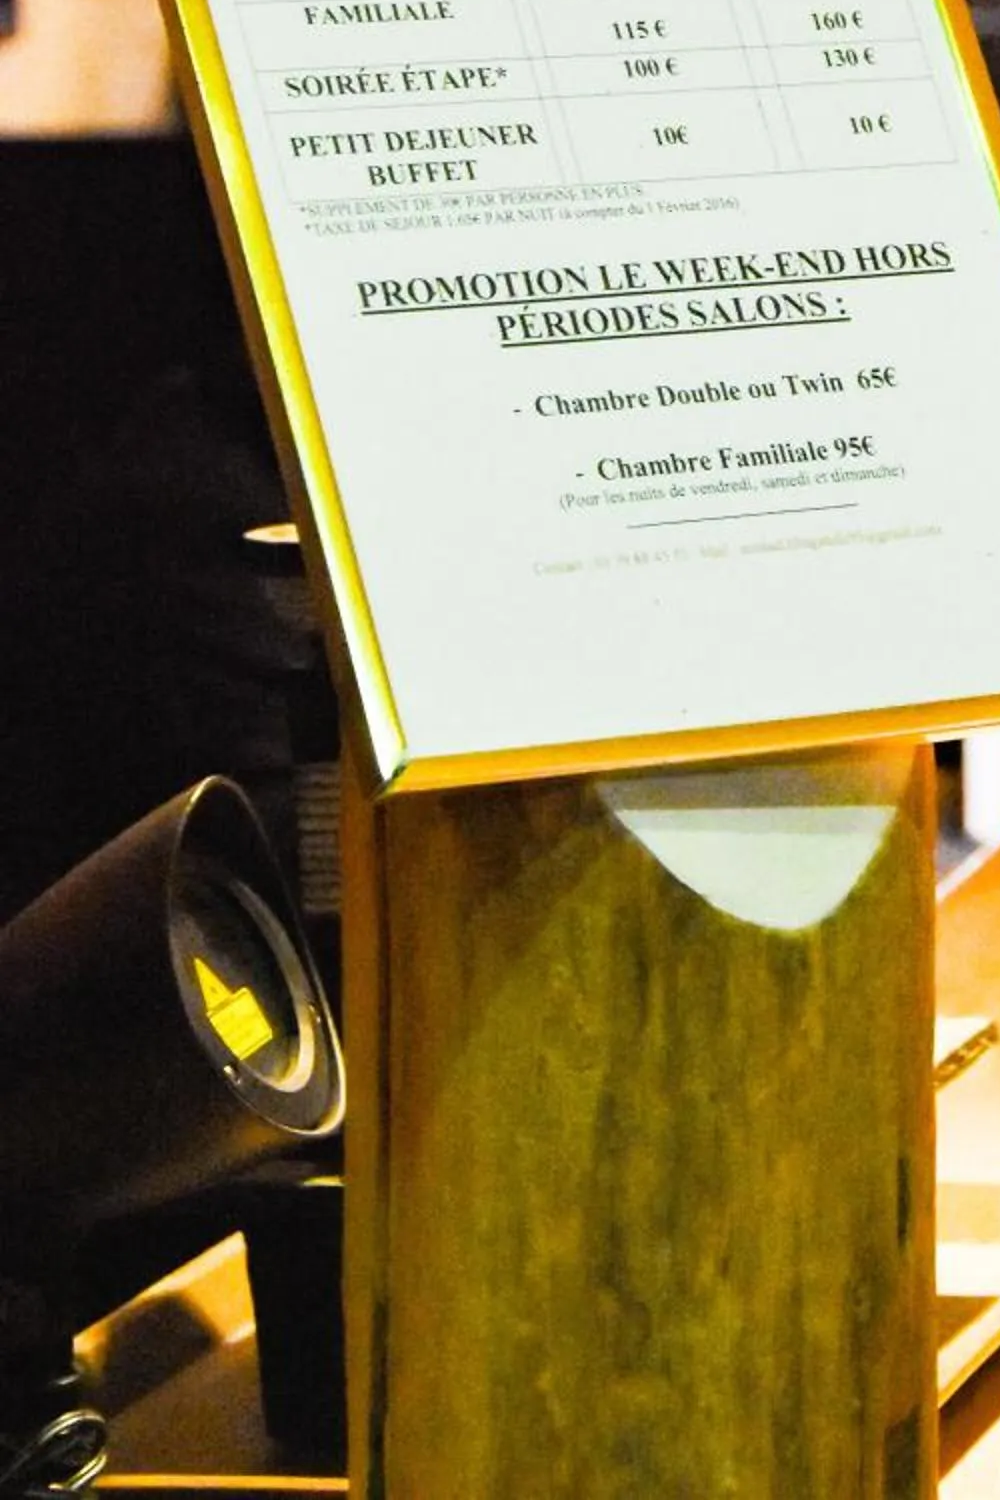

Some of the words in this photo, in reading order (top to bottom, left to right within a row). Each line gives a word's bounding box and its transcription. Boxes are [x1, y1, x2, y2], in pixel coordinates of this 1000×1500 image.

[304, 2, 454, 25] FAMILIALE
[812, 12, 847, 31] 160
[852, 10, 864, 28] €
[612, 21, 648, 40] 115
[655, 20, 666, 37] €
[624, 59, 659, 78] 100
[666, 57, 679, 75] €
[823, 49, 858, 68] 130
[864, 47, 876, 65] €
[285, 68, 394, 97] SOIRÉE
[653, 126, 689, 146] 10€
[850, 116, 872, 134] 10
[879, 114, 892, 132] €
[290, 132, 377, 157] PETIT
[385, 124, 538, 152] DEJEUNER
[368, 161, 479, 186] BUFFET
[357, 266, 588, 308] PROMOTION
[598, 263, 646, 290] LE
[653, 249, 845, 285] WEEK-END
[853, 241, 951, 272] HORS
[497, 302, 680, 341] PÉRIODES
[687, 291, 827, 329] SALONS
[535, 388, 649, 418] Chambre
[655, 380, 742, 407] Double
[748, 380, 777, 400] ou
[781, 372, 844, 396] Twin
[857, 367, 897, 390] 65€
[597, 450, 712, 482] Chambre
[718, 441, 828, 471] Familiale
[833, 435, 876, 460] 95€
[559, 492, 600, 513] (Pour
[603, 489, 625, 504] les
[629, 487, 665, 503] nuits
[670, 483, 685, 498] de
[761, 470, 811, 489] samedi
[815, 472, 828, 484] et
[830, 465, 905, 484] dimanche)
